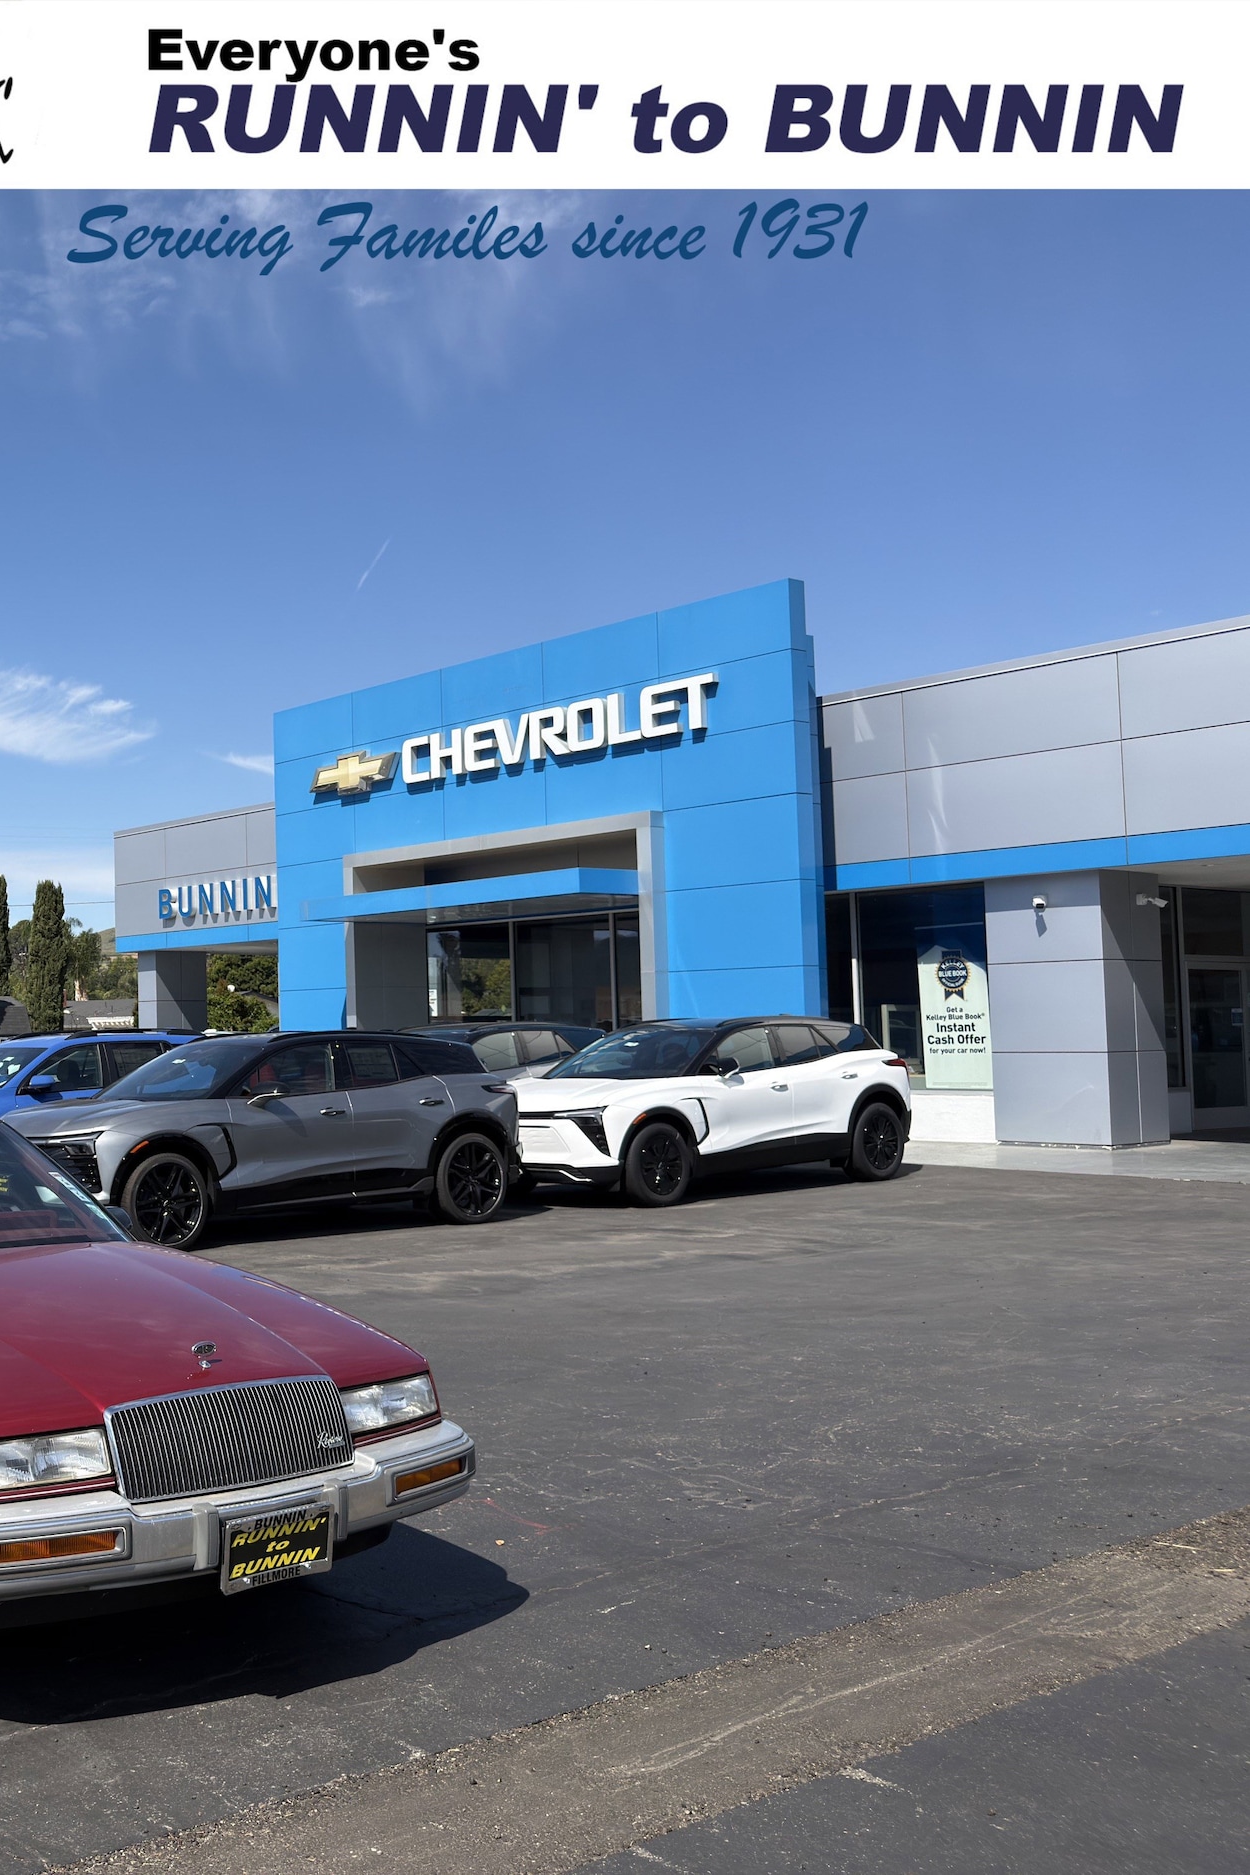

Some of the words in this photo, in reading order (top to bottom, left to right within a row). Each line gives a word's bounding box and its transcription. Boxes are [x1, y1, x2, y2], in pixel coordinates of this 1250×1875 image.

[401, 672, 719, 784] CHEVROLET
[158, 875, 277, 919] BUNNIN
[940, 959, 965, 969] KELLEY
[938, 970, 952, 978] BLUE
[952, 969, 967, 977] BOOK
[936, 1022, 976, 1033] Instant
[927, 1034, 954, 1045] Cash
[957, 1034, 986, 1044] Offer
[254, 1509, 307, 1530] BUNNIN
[265, 1540, 290, 1552] to
[229, 1546, 321, 1579] BUNNIN
[251, 1566, 301, 1586] FILLMORE
